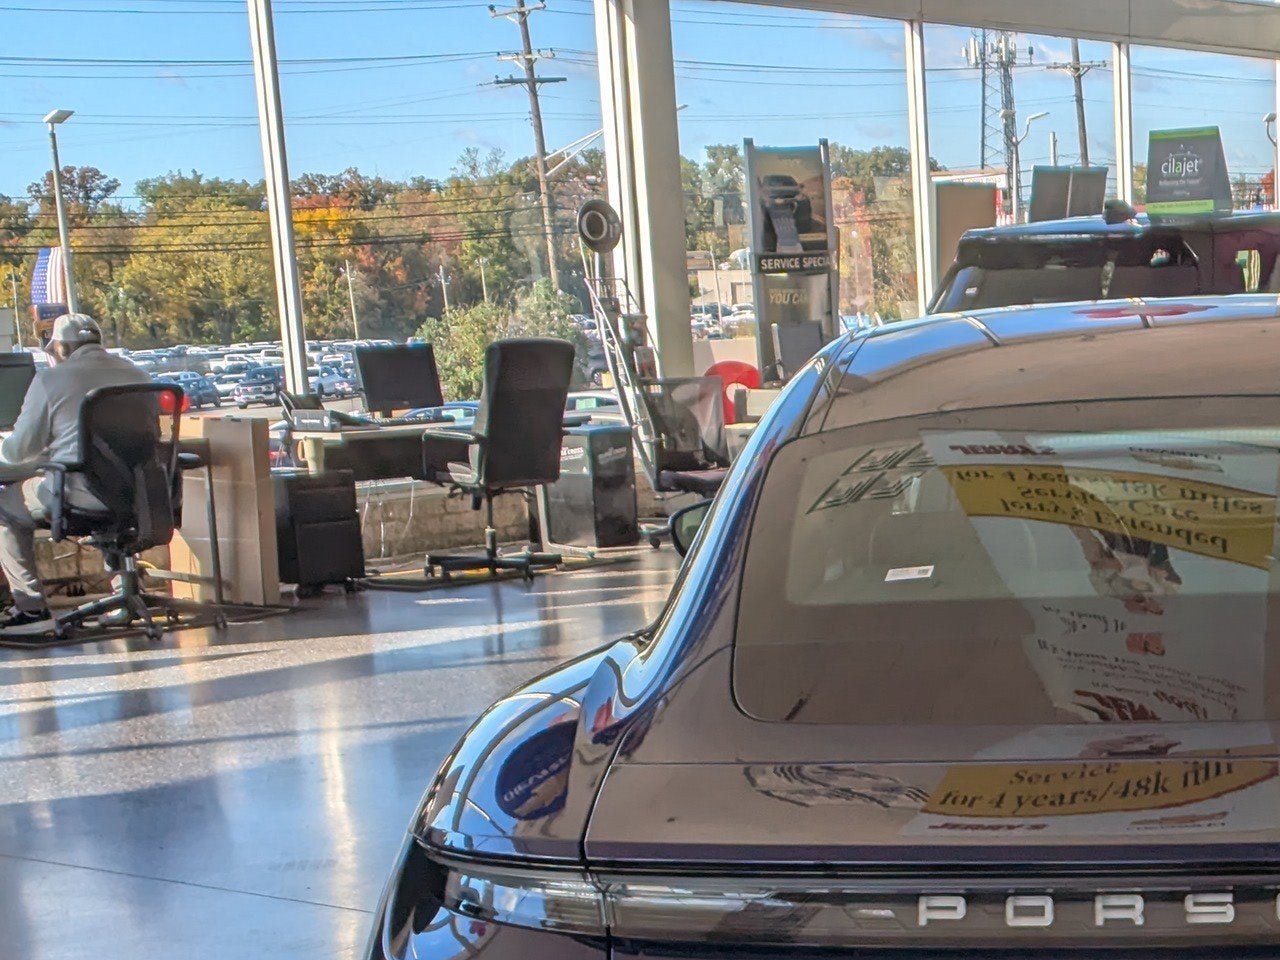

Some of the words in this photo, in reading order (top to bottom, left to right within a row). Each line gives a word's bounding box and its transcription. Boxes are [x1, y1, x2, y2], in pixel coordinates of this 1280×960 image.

[1161, 157, 1199, 177] cilajet
[761, 258, 800, 270] SERVICE
[769, 292, 790, 304] YOU
[1010, 762, 1121, 785] Service
[939, 790, 982, 808] for
[988, 792, 1006, 809] 4
